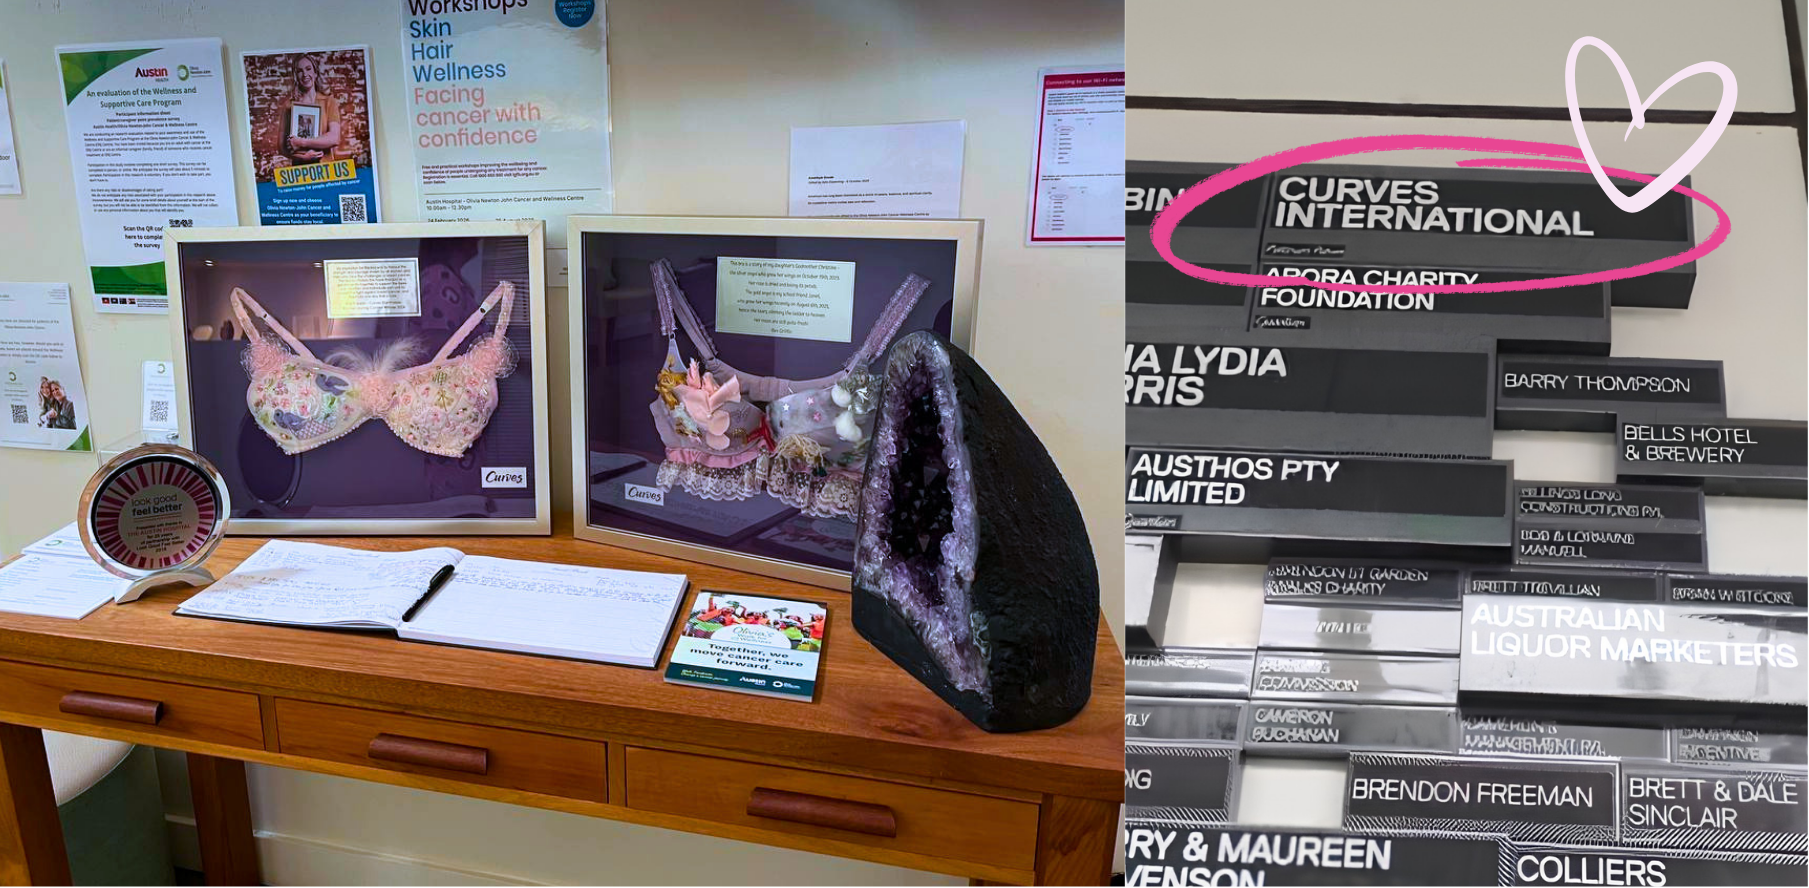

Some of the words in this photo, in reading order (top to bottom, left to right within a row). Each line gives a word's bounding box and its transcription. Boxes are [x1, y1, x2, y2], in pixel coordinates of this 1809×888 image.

[410, 0, 528, 16] Workshops
[410, 18, 452, 38] Skin
[411, 40, 453, 61] Hair
[135, 67, 168, 78] Austin
[412, 62, 506, 82] Wellness
[96, 88, 132, 97] evaluation
[132, 88, 140, 96] of
[140, 88, 152, 96] the
[152, 87, 182, 96] Wellness
[183, 86, 197, 94] and
[414, 84, 485, 108] Facing
[100, 100, 136, 109] Supportive
[137, 100, 151, 108] Care
[152, 99, 182, 109] Program
[416, 108, 491, 126] cancer
[495, 102, 541, 122] with
[418, 127, 538, 148] confidence
[280, 164, 330, 185] SUPPORT
[334, 161, 350, 178] US
[1278, 176, 1439, 205] CURVES
[1275, 202, 1595, 237] INTERNATIONAL
[1363, 270, 1479, 286] CHARITY
[1260, 288, 1435, 310] FOUNDATION
[1172, 345, 1287, 378] LYDIA
[1504, 373, 1569, 391] BARRY
[1574, 375, 1690, 392] THOMPSON
[1624, 424, 1686, 442] BELLS
[1690, 426, 1758, 444] HOTEL
[1625, 444, 1640, 461] &
[1646, 445, 1745, 464] BREWERY
[486, 470, 523, 484] Curves
[1131, 453, 1273, 480] AUSTHOS
[1281, 458, 1340, 483] PTY
[132, 497, 151, 506] look
[153, 494, 177, 505] good
[628, 486, 661, 502] Curves
[1127, 478, 1246, 505] LIMITED
[132, 507, 151, 516] feel
[153, 503, 182, 514] better
[1470, 603, 1666, 632] AUSTRALIAN
[732, 626, 774, 638] Olivia's
[690, 648, 724, 658] move
[727, 651, 772, 663] cancer
[774, 658, 804, 667] care
[708, 643, 766, 657] Together,
[769, 651, 789, 659] we
[1470, 631, 1592, 660] LIQUOR
[1600, 636, 1800, 668] MARKETERS
[716, 658, 772, 671] forward.
[1255, 708, 1334, 726] CAMERON
[1352, 778, 1470, 804] BRENDON
[1477, 783, 1594, 808] FREEMAN
[1629, 777, 1706, 800] BRETT
[1714, 780, 1732, 802] &
[1738, 781, 1800, 804] DALE
[1629, 804, 1738, 830] SINCLAIR
[1125, 829, 1178, 860] RY
[1182, 831, 1209, 862] &
[1217, 832, 1392, 870] MAUREEN
[1517, 854, 1668, 887] COLLIERS
